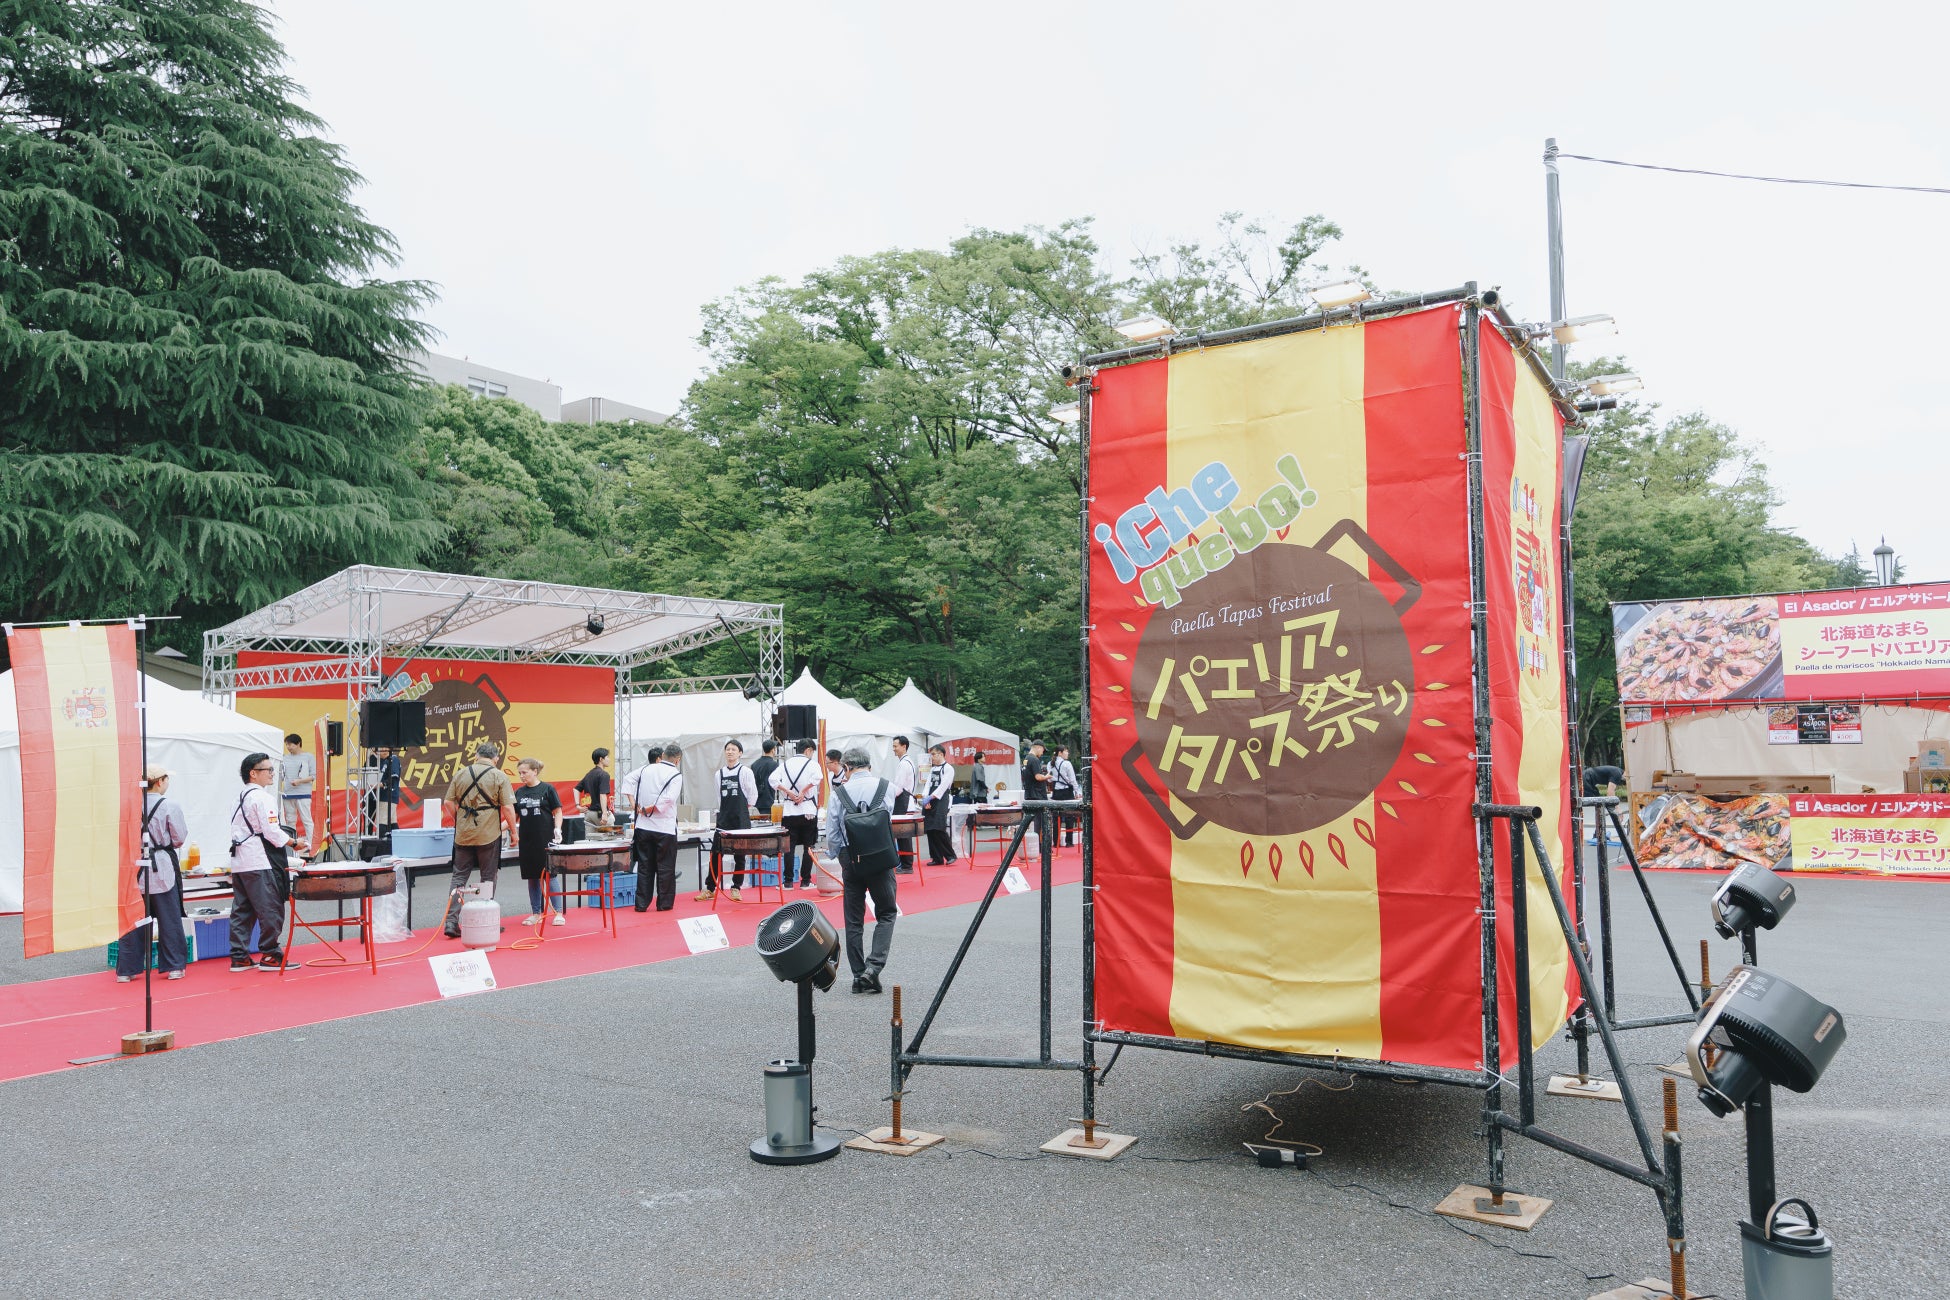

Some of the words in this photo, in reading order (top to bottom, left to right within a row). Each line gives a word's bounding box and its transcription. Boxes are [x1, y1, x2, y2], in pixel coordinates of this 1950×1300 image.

[1170, 611, 1215, 635] Paella
[1218, 605, 1263, 627] Tapas
[1268, 584, 1334, 614] Festival
[1784, 602, 1797, 613] El
[1802, 599, 1857, 612] Asador
[1820, 620, 1930, 642] 北海道なまら
[1795, 663, 1820, 671] Paella
[1822, 663, 1833, 671] de
[1835, 661, 1875, 670] mariscos
[433, 704, 453, 716] Tapas
[454, 699, 480, 711] Festival
[1795, 801, 1809, 812] El
[1813, 800, 1868, 813] Asador
[1831, 827, 1939, 844] 北海道なまら
[1810, 847, 1950, 863] シーフードパエリ
